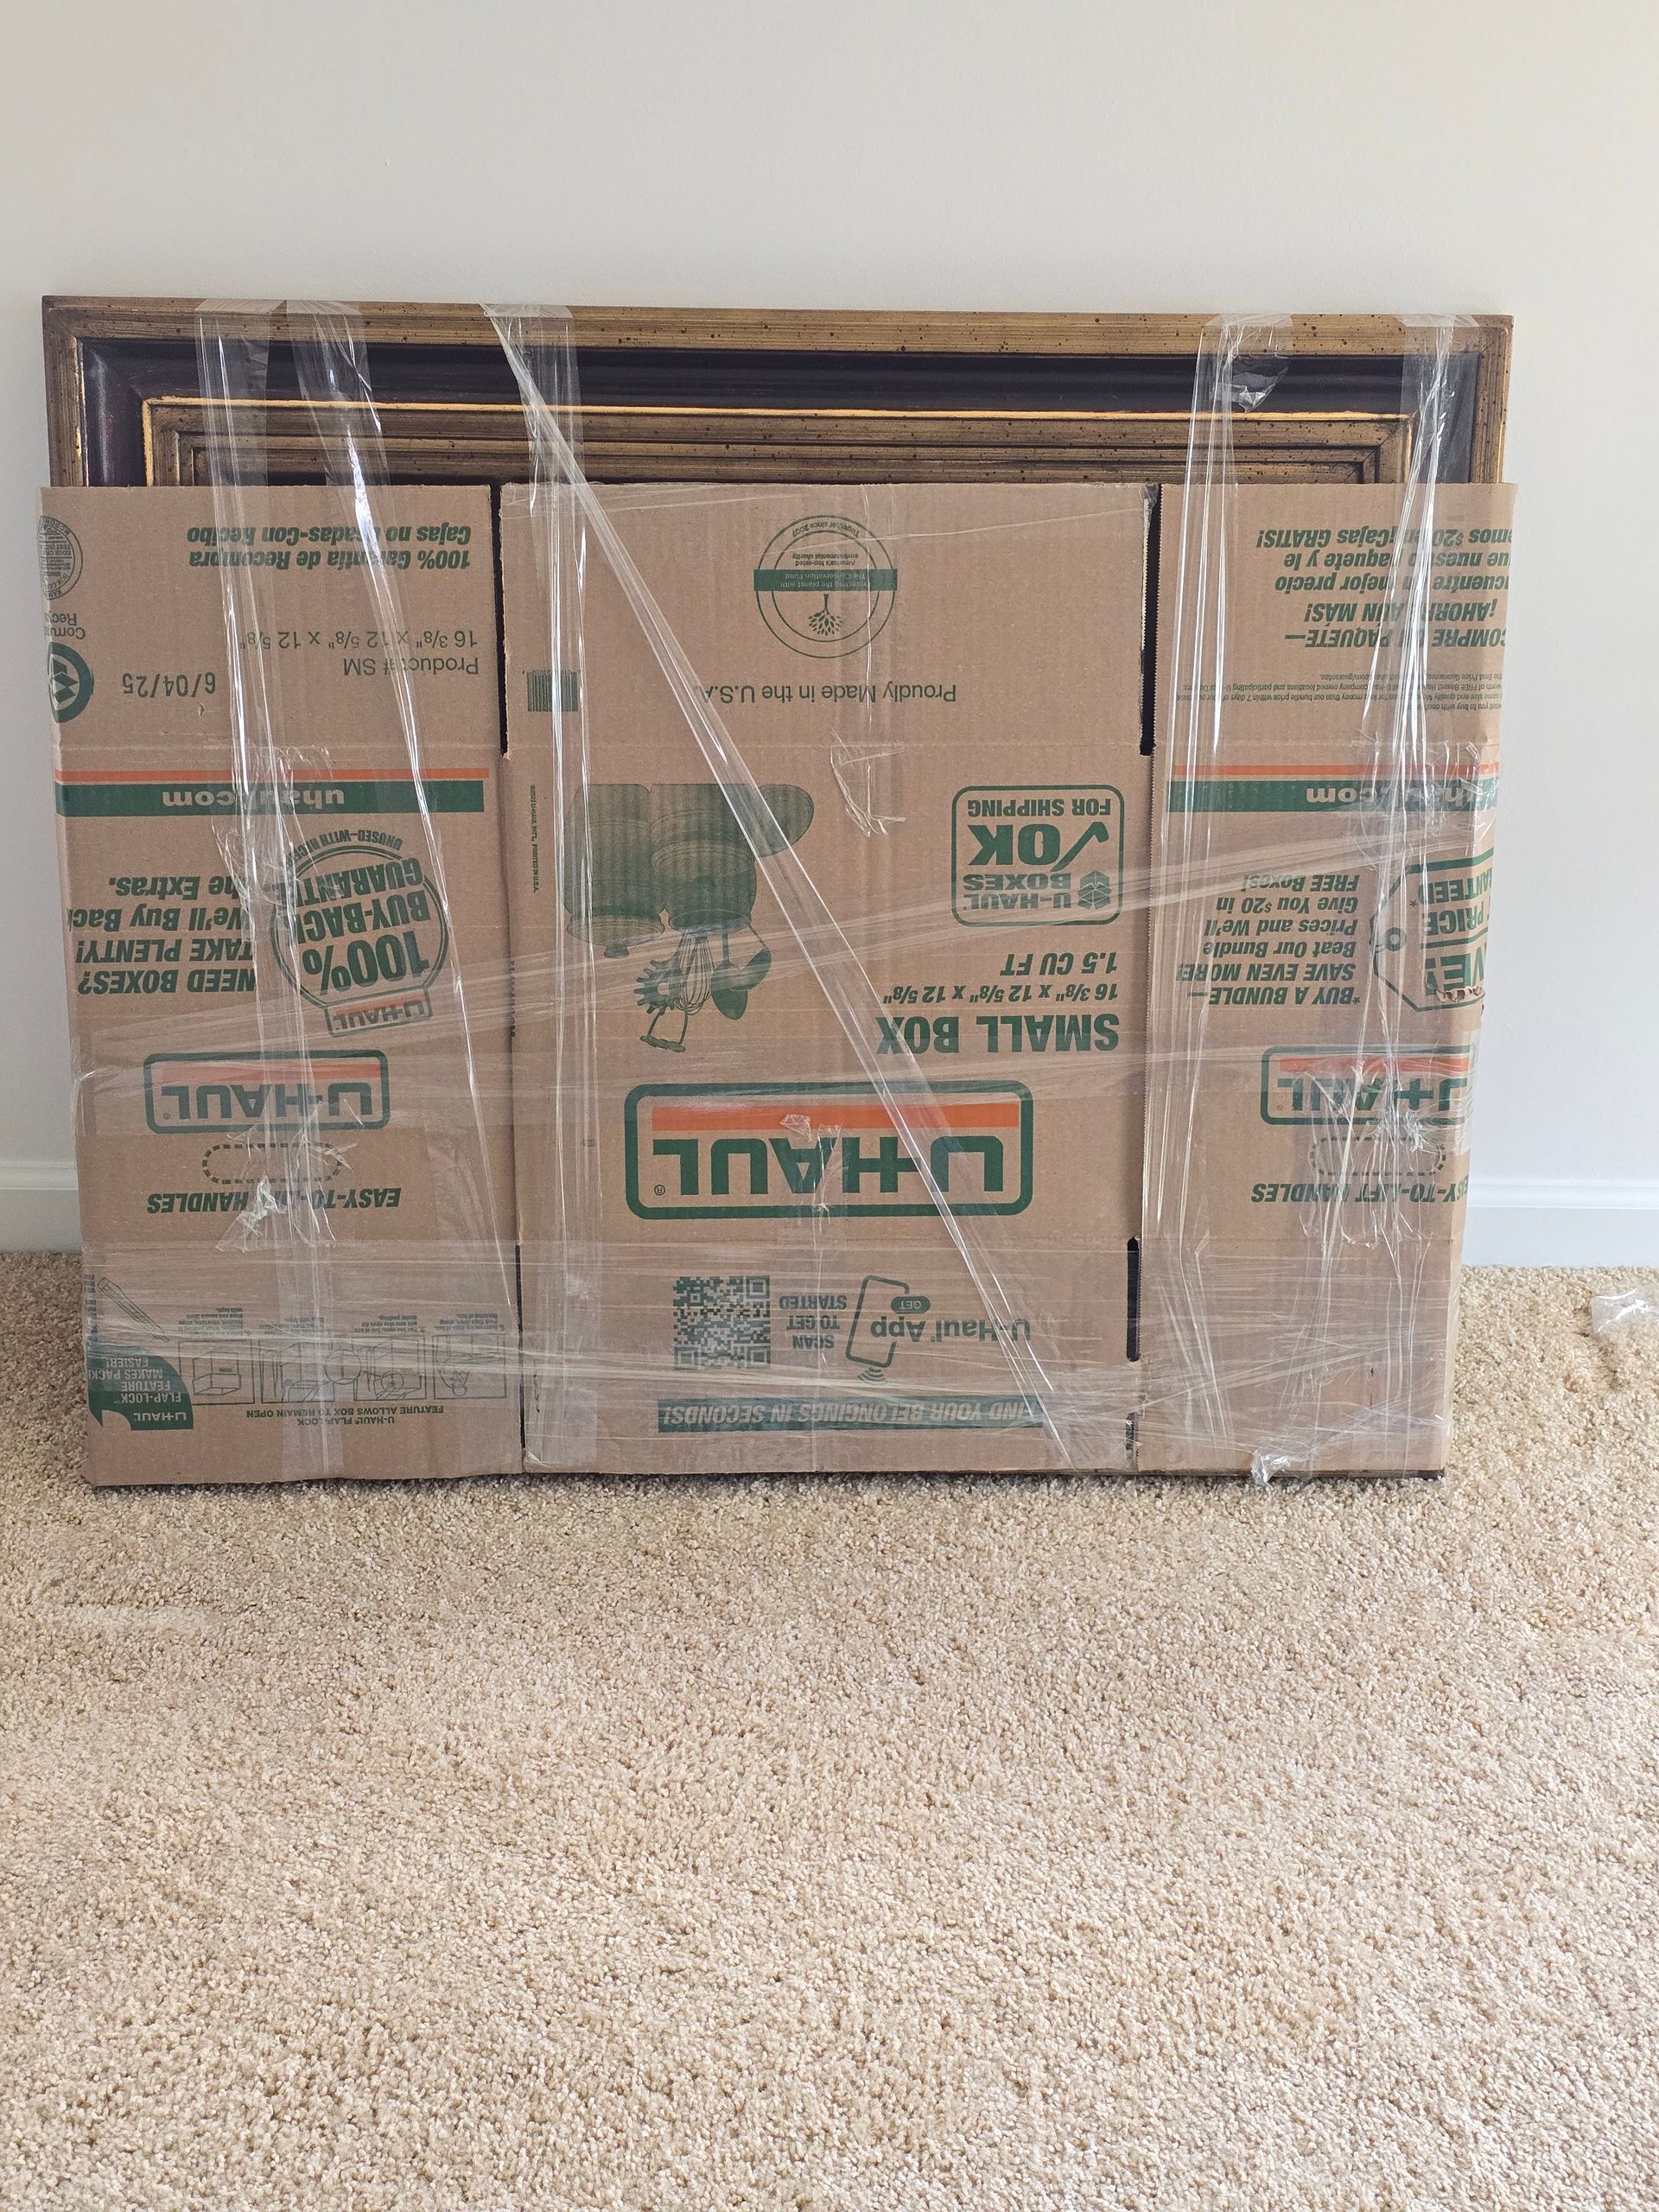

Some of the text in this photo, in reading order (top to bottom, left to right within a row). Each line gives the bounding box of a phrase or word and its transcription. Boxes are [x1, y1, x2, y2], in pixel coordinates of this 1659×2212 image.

[187, 522, 471, 546] Cajas no Recibo
[1256, 529, 1332, 548] GRATIS!
[189, 548, 290, 570] Recompra
[296, 551, 321, 570] de
[417, 550, 471, 569] 100%
[1283, 553, 1302, 570] le
[1307, 549, 1319, 567] y
[798, 580, 819, 588] planet
[1275, 572, 1336, 594] precio
[1304, 603, 1358, 627] MÁS!
[278, 631, 301, 649] 12
[308, 632, 320, 645] x
[366, 631, 389, 648] 12
[396, 631, 409, 645] x
[454, 630, 477, 648] 16
[1431, 628, 1506, 647] COMPRE
[343, 658, 376, 676] SM
[401, 657, 479, 675] Product
[121, 671, 216, 698] 6/04/25
[762, 685, 793, 702] the
[799, 685, 815, 702] in
[822, 685, 876, 702] Made
[882, 681, 957, 702] Proudly
[1232, 683, 1272, 692] participating
[1457, 702, 1468, 711] buy
[967, 798, 1111, 817] FOR SHIPPING
[967, 823, 1060, 866] OK
[108, 876, 200, 900] Extras.
[963, 873, 1071, 891] BOXES
[1241, 874, 1360, 893] FREE Boxes!
[1216, 897, 1358, 914] Give You $20 in
[129, 904, 181, 931] Buy
[1256, 919, 1294, 936] and
[1298, 919, 1357, 937] Prices
[75, 938, 252, 963] TAKE PLENTY!
[1202, 941, 1357, 958] Beat Our Bundle
[302, 931, 429, 995] 100%
[1000, 952, 1117, 976] 1.5 CU FT
[1247, 963, 1299, 982] EVEN
[1304, 963, 1356, 982] SAVE
[78, 969, 255, 995] NEED BOXES?
[921, 986, 945, 1002] 12
[951, 985, 967, 1001] x
[1007, 985, 1033, 1001] 12
[1038, 984, 1052, 999] x
[1095, 983, 1118, 1001] 16
[1294, 987, 1309, 1005] A
[875, 1014, 1120, 1055] SMALL BOX
[1250, 1182, 1350, 1205] HANDLES
[147, 1192, 249, 1214] HANDLES
[779, 1294, 848, 1310] STARTED
[898, 1300, 922, 1310] GET
[786, 1315, 840, 1331] TO GET
[870, 1316, 926, 1343] App
[791, 1334, 835, 1349] SCAN
[106, 1357, 148, 1368] EASIER!
[125, 1368, 162, 1380] MAKES
[121, 1381, 170, 1391] FEATURE
[276, 1408, 315, 1418] REMAIN
[663, 1404, 766, 1425] SECONDS!
[770, 1403, 792, 1422] IN
[797, 1402, 923, 1423] BELONGINGS
[929, 1402, 982, 1422] YOUR
